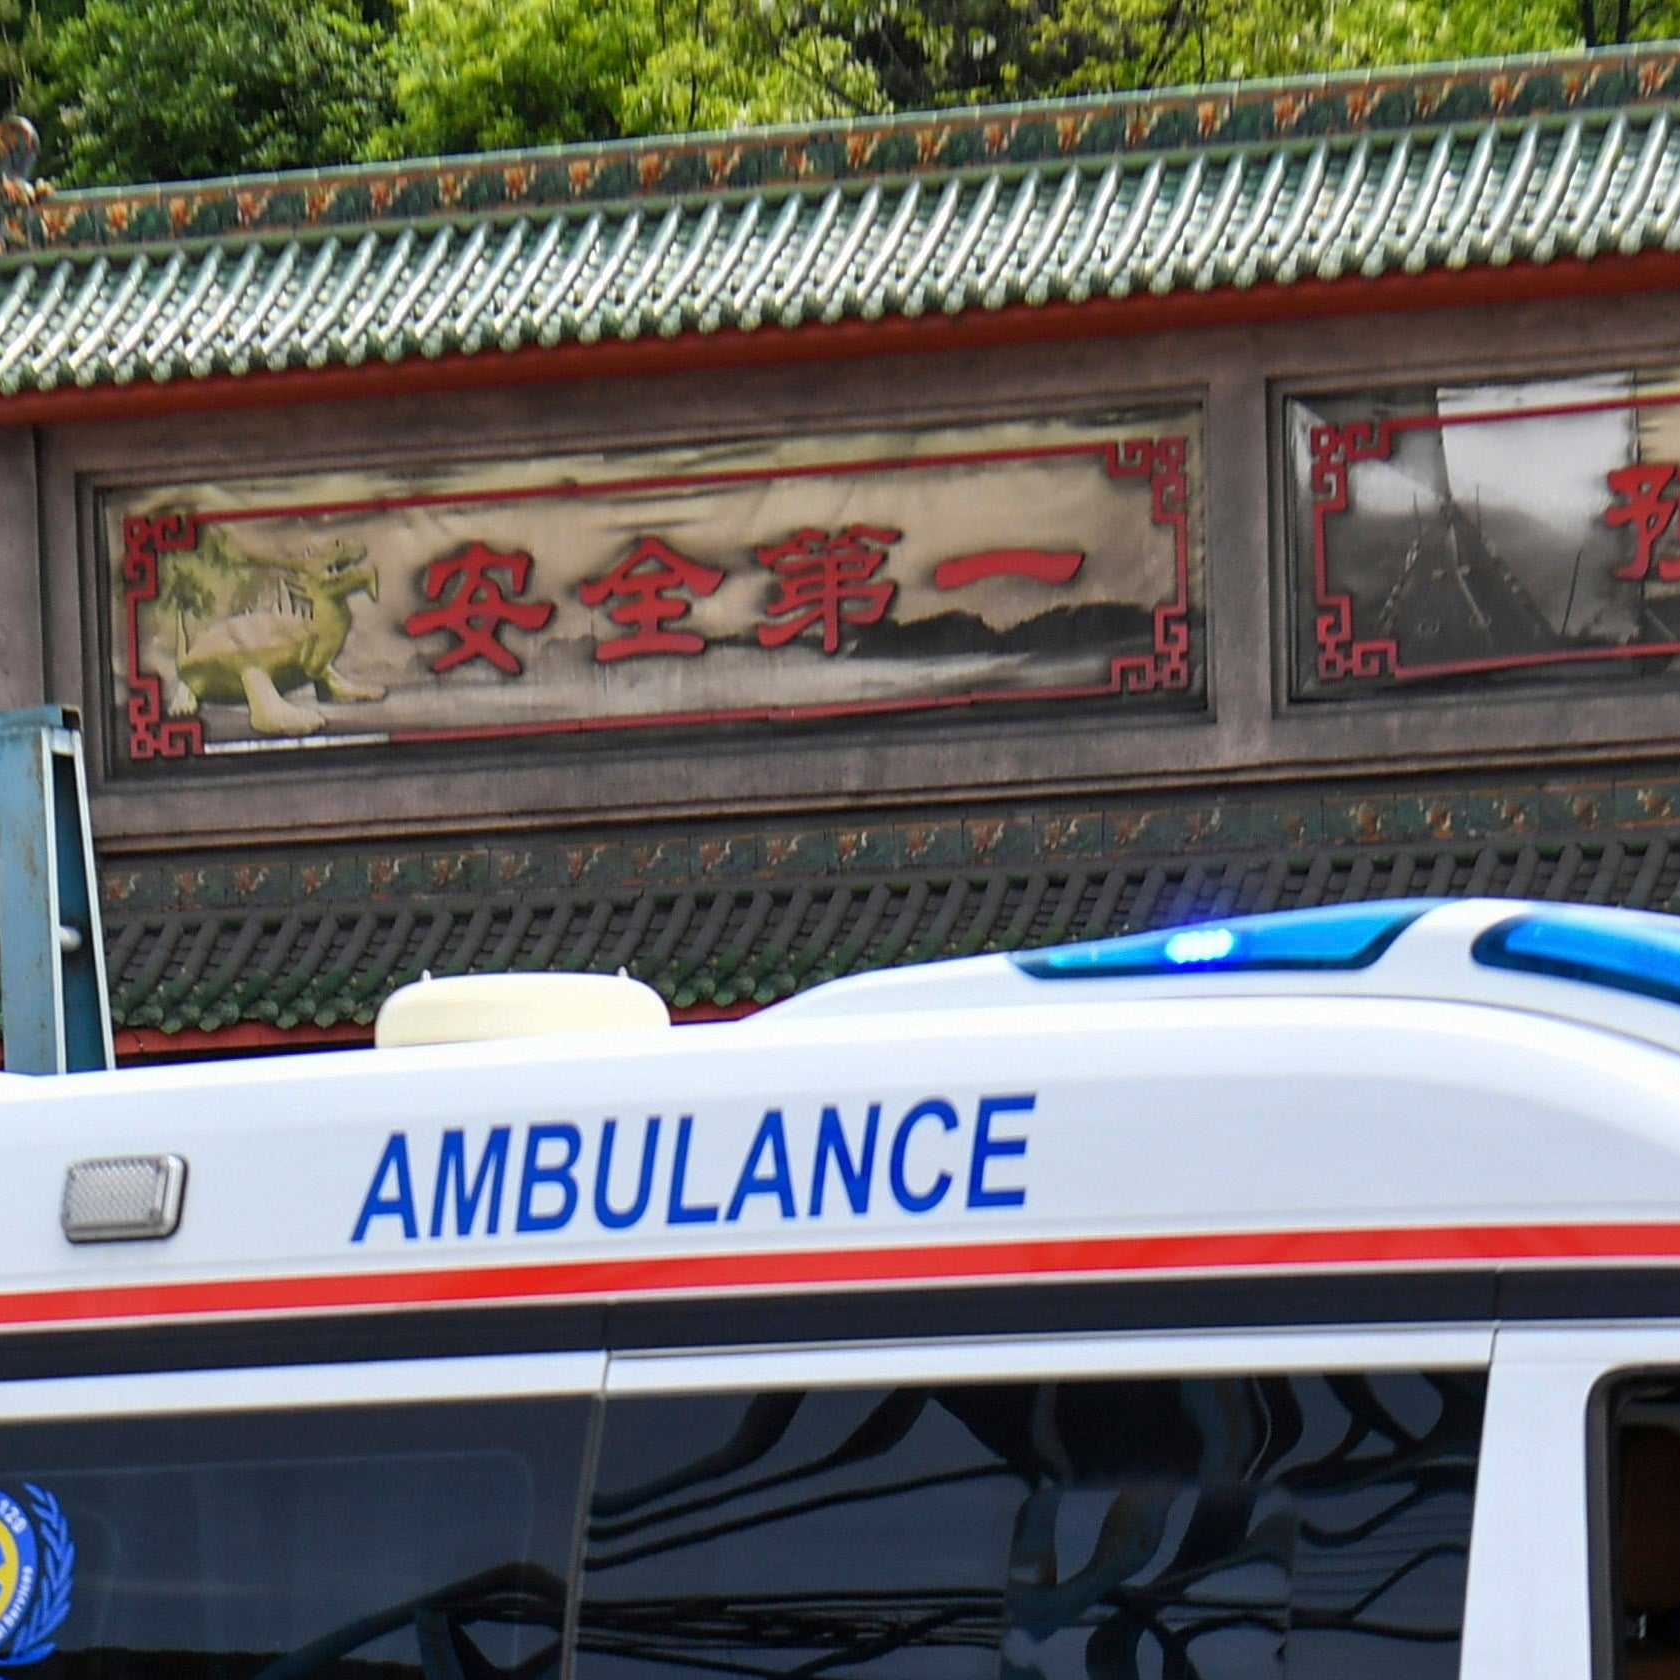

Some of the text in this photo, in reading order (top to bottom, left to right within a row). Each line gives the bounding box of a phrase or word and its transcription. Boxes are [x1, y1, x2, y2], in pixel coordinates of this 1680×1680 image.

[404, 522, 1086, 676] 安全第一
[350, 1091, 1038, 1244] AMBULANCE
